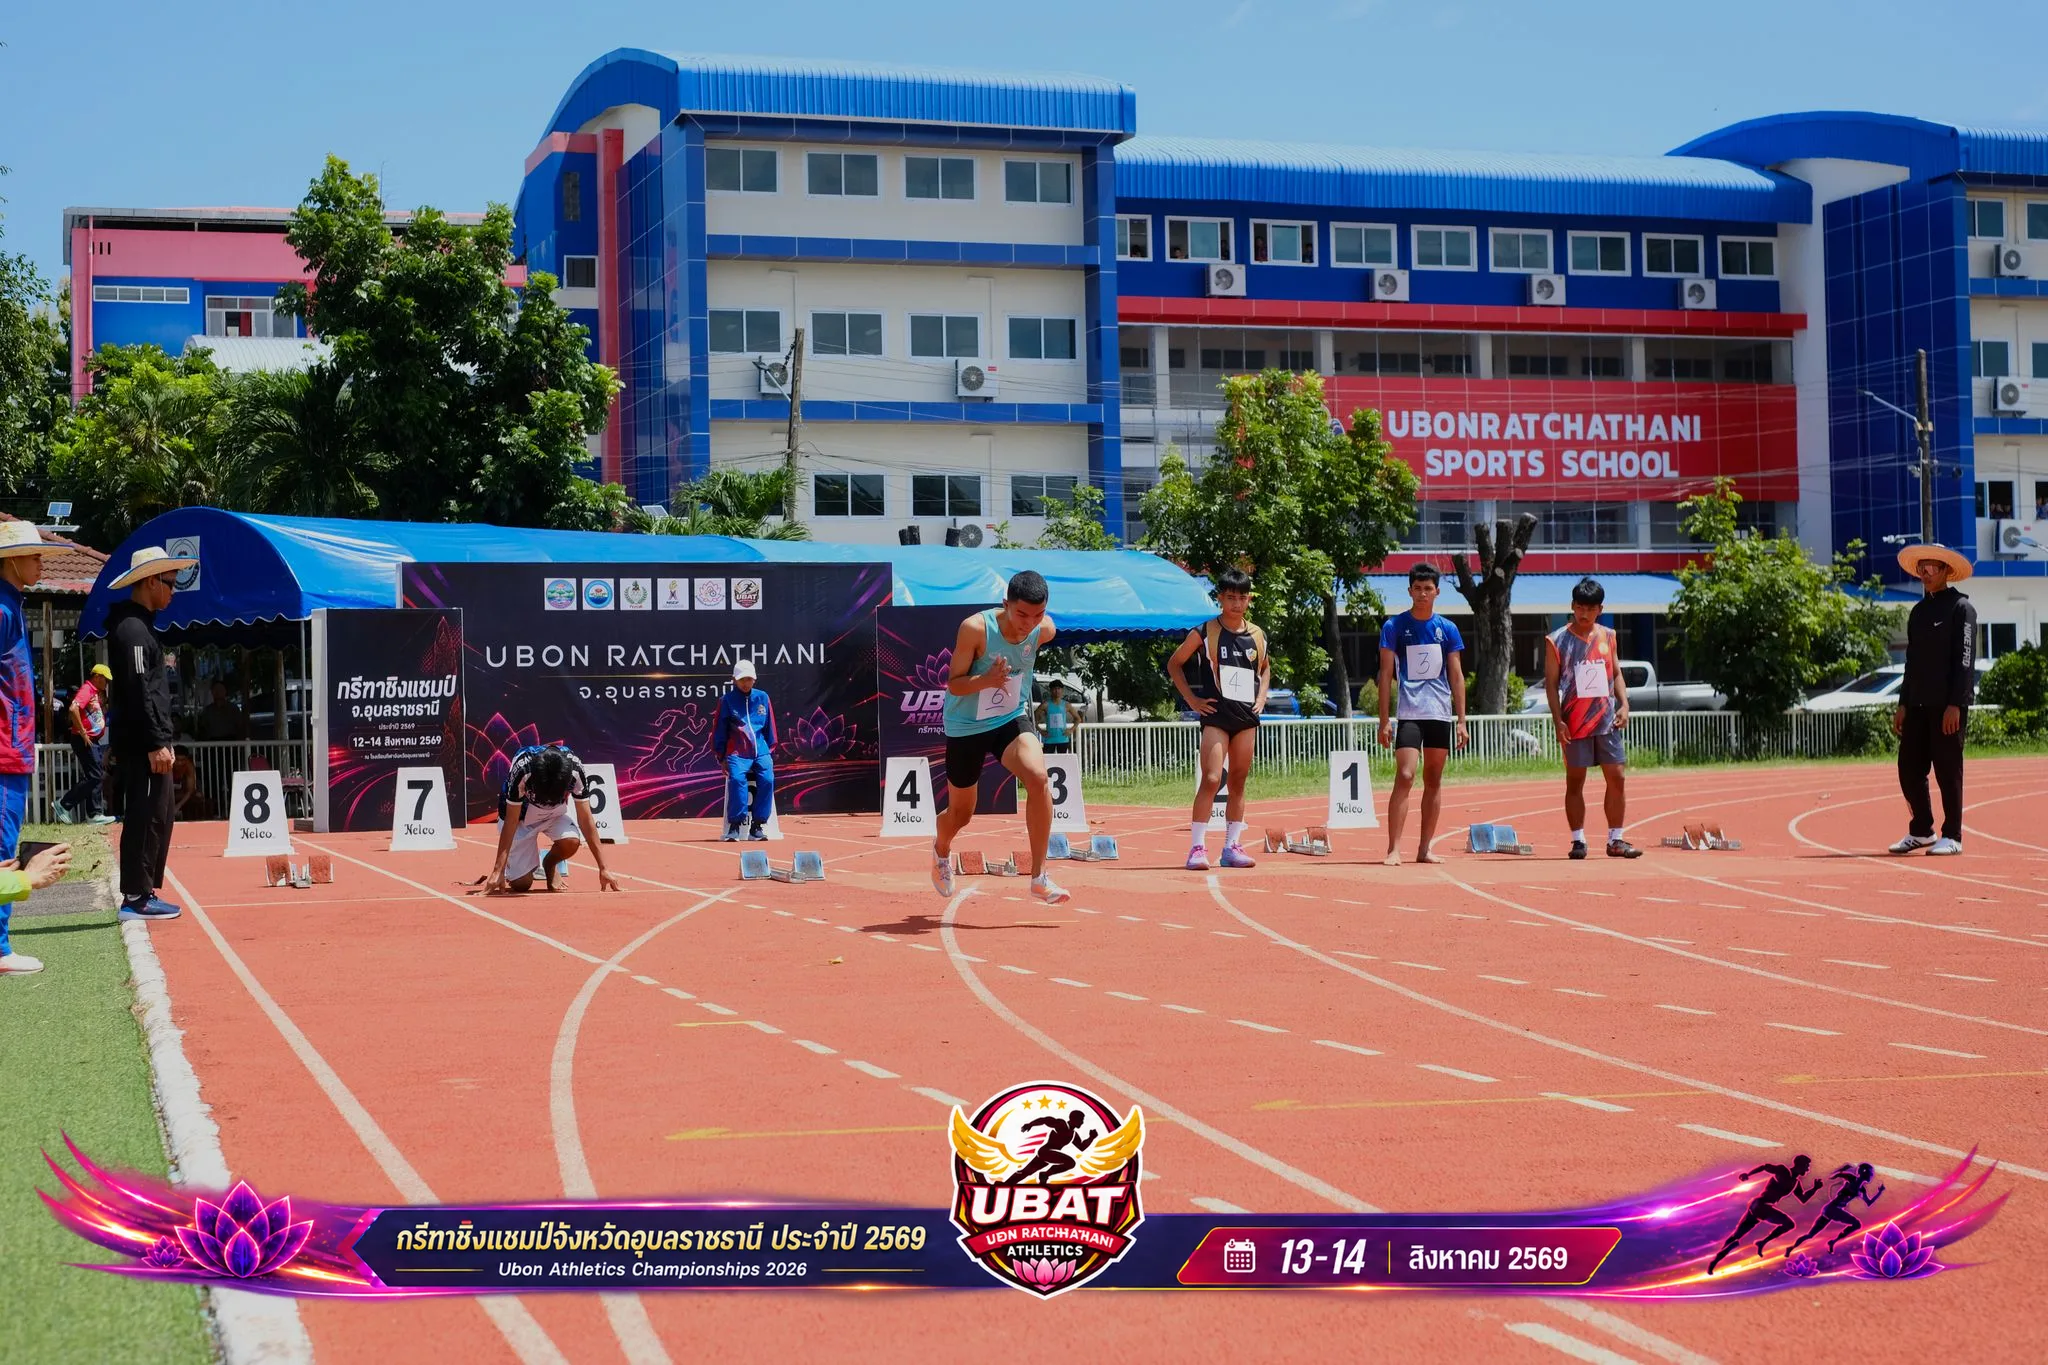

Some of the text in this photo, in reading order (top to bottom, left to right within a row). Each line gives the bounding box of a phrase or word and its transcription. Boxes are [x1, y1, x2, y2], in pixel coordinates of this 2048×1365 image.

[1387, 410, 1701, 442] UBONRATCHATHANI
[1425, 448, 1680, 479] SPORTS SCHOOL
[485, 642, 826, 668] UBON RATCHATHANI
[1962, 621, 1972, 668] NIKE PRO
[1415, 652, 1431, 675] 3
[1229, 671, 1241, 693] 4
[1584, 668, 1598, 691] 2
[991, 687, 1005, 705] 6
[351, 699, 440, 721] จ.อุบลราชธานี
[384, 735, 417, 747] สิงหาคม
[419, 734, 442, 746] 2569
[896, 770, 921, 809] 4
[1046, 766, 1068, 806] 3
[1342, 762, 1359, 801] 1
[243, 783, 271, 824] 8
[407, 779, 434, 821] 7
[586, 774, 607, 815] 6
[893, 811, 922, 823] Nelco
[1336, 802, 1363, 814] Nelco
[240, 826, 273, 840] Nelco
[404, 823, 435, 836] Nelco
